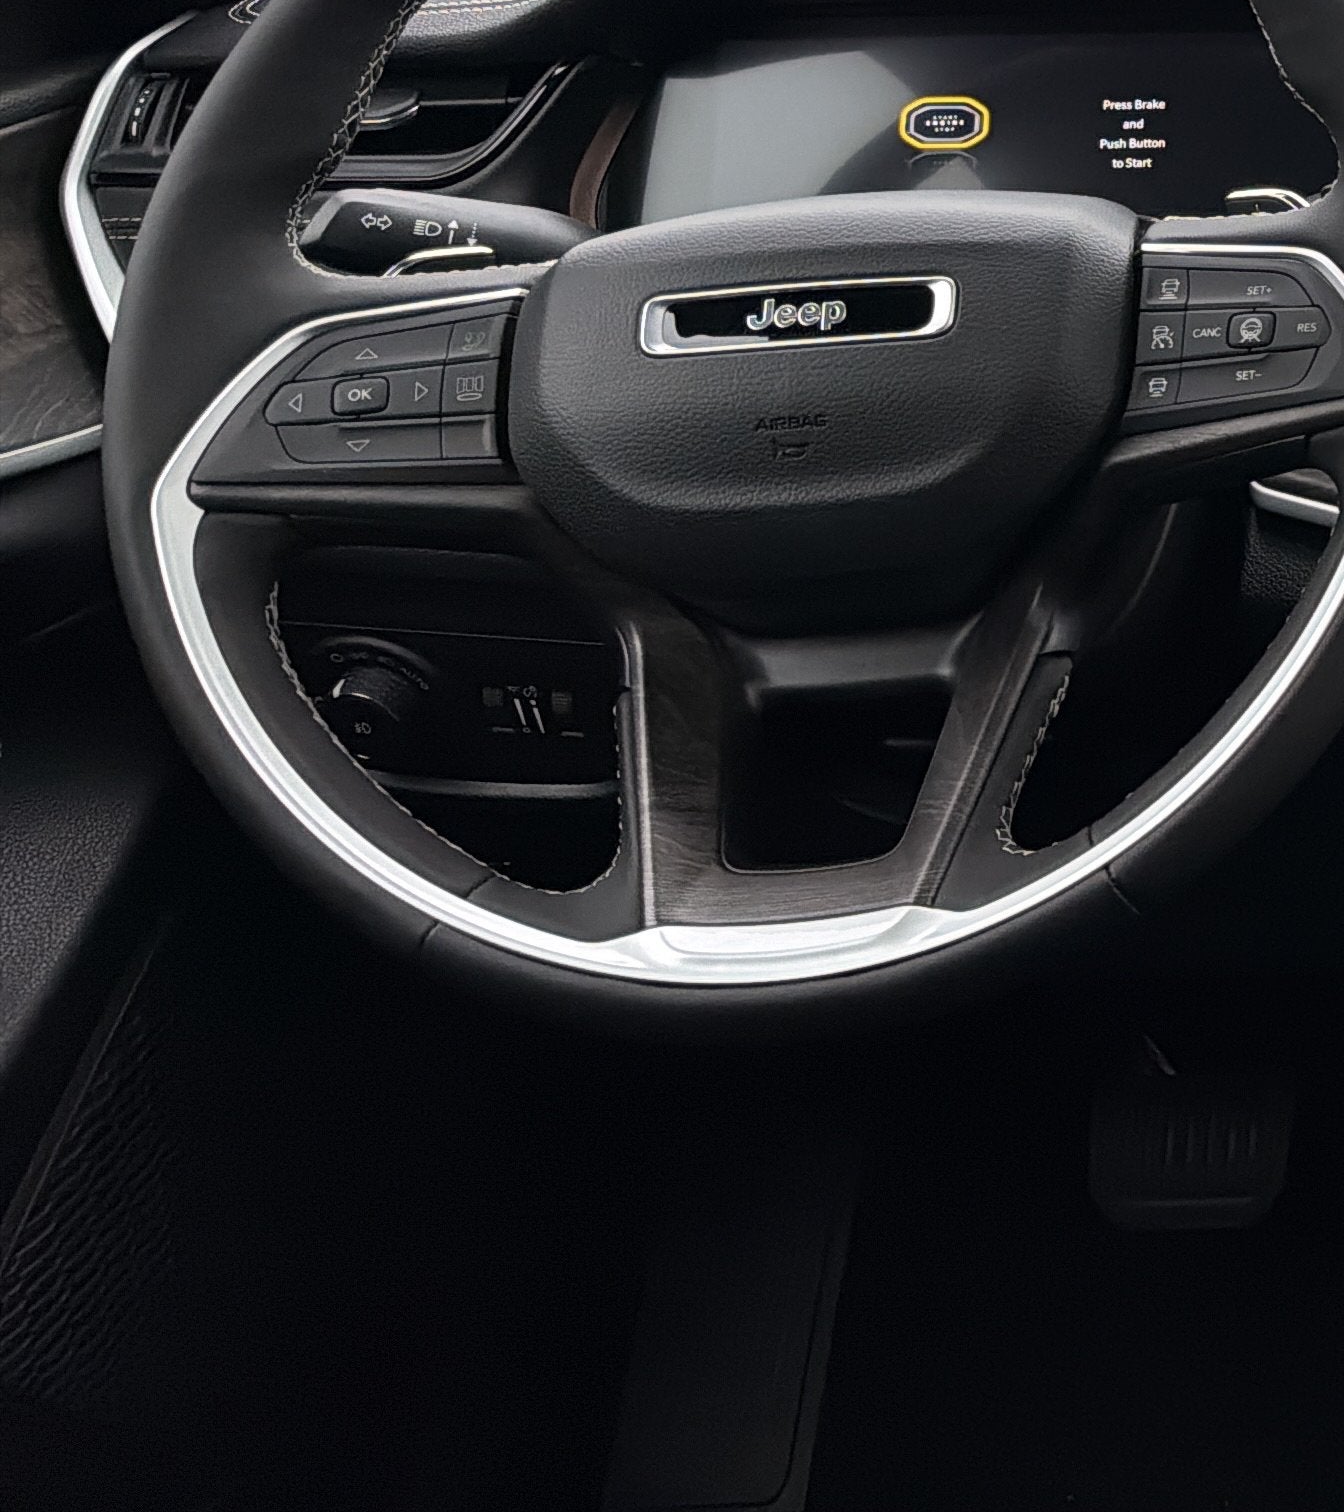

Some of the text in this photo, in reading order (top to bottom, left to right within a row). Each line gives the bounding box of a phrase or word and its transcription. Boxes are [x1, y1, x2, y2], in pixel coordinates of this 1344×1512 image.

[1102, 98, 1166, 110] Press Brake
[1122, 118, 1145, 130] and
[1099, 137, 1166, 150] Push Button
[1112, 157, 1153, 168] to Start
[746, 298, 847, 331] Jeep
[1192, 327, 1223, 339] CANC
[1296, 322, 1318, 333] RES
[347, 387, 373, 402] OK
[755, 414, 828, 432] AIRBAG
